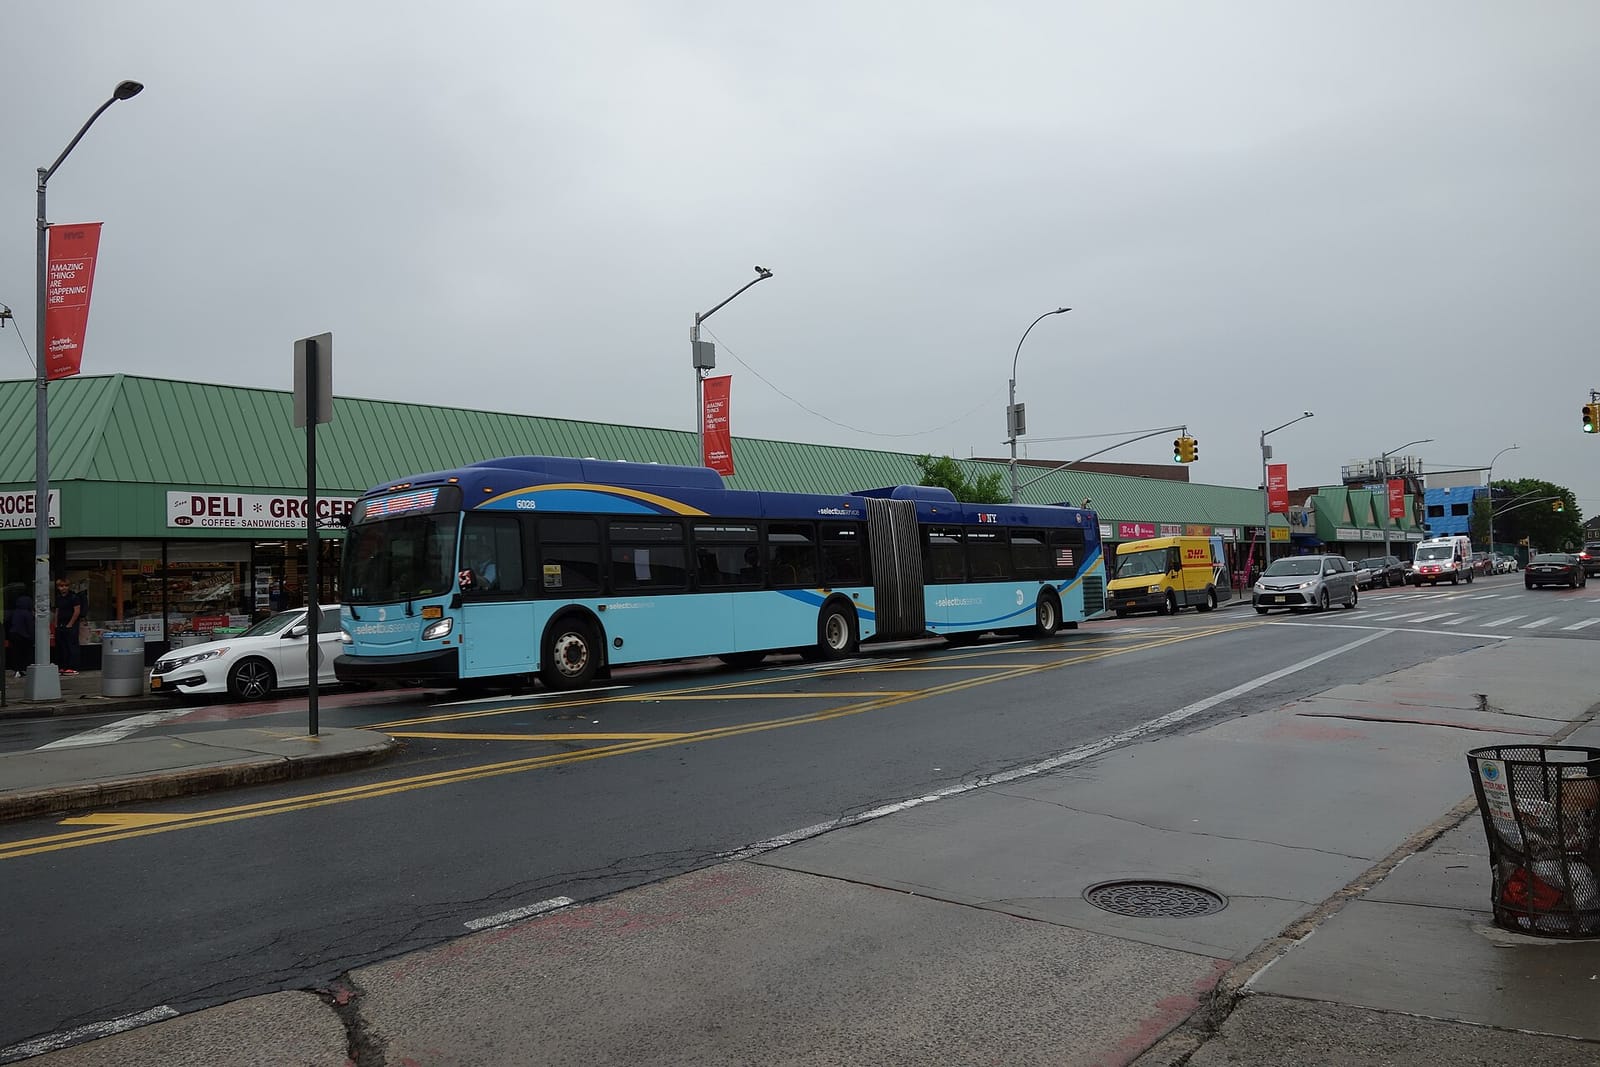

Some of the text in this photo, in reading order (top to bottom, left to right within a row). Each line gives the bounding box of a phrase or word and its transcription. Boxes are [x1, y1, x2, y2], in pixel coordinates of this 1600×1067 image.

[51, 263, 84, 271] AMAZING
[51, 271, 76, 279] THINGS
[50, 279, 62, 287] ARE
[49, 286, 87, 296] HAPPENING
[49, 295, 65, 304] HERE
[191, 496, 243, 517] DELI
[269, 498, 357, 519] GROCER
[516, 499, 536, 509] 6028
[201, 518, 236, 527] COFFEE
[241, 519, 296, 528] SANDWICHES
[1186, 549, 1206, 559] DHL
